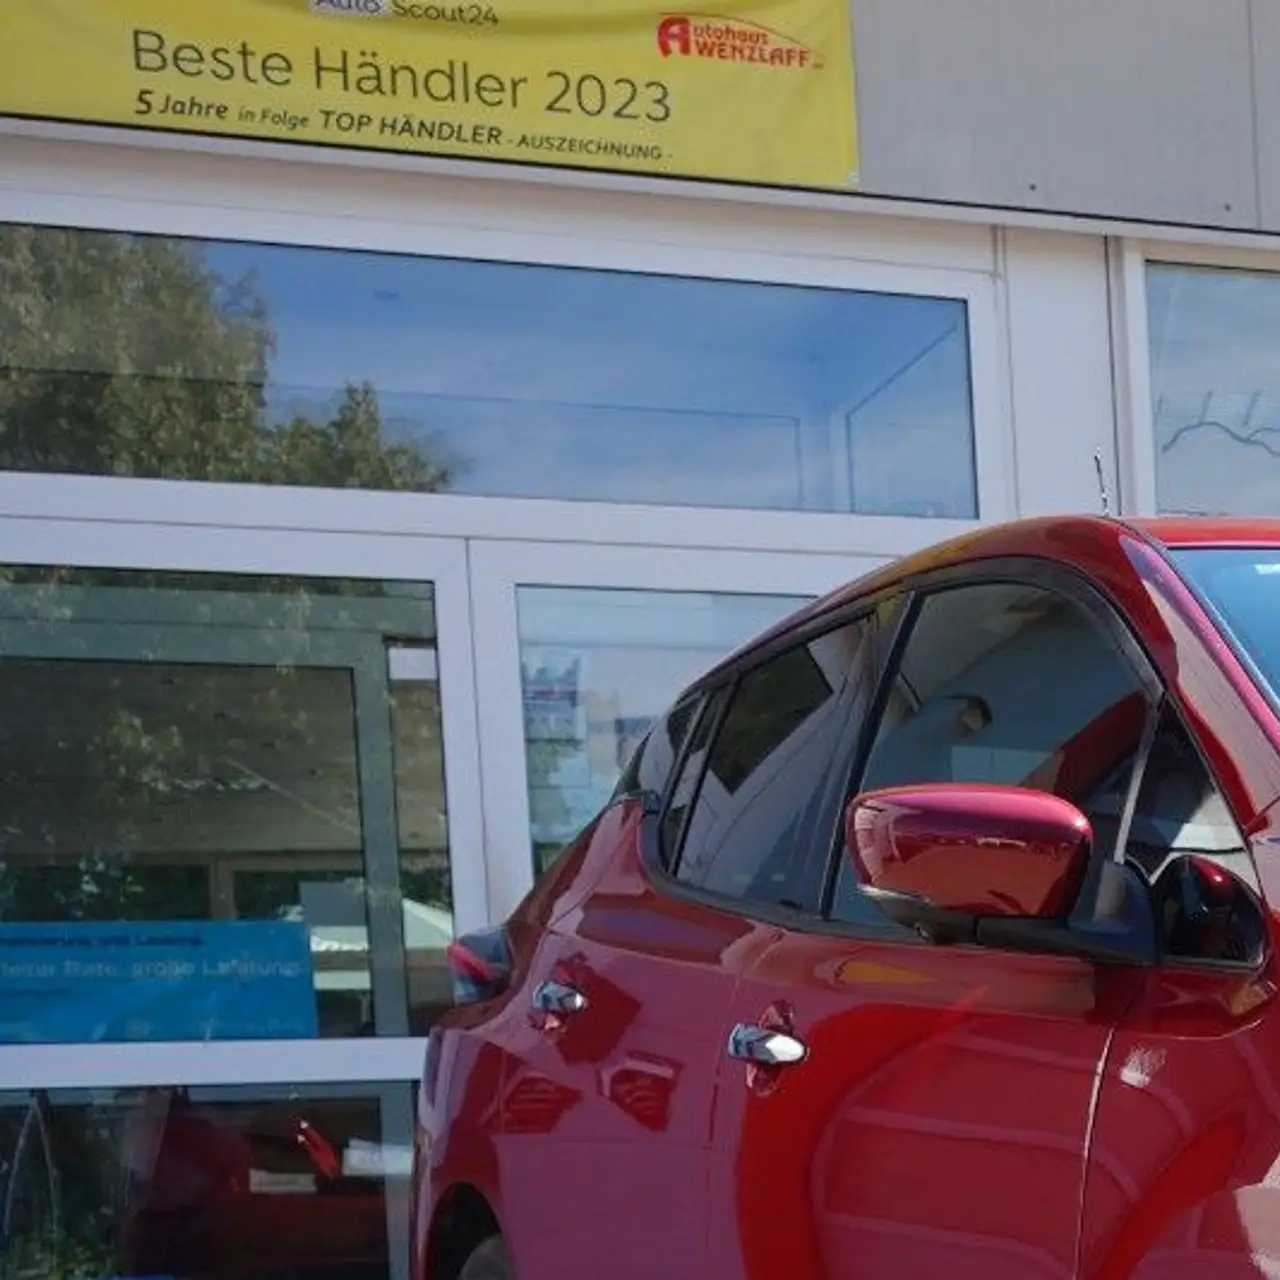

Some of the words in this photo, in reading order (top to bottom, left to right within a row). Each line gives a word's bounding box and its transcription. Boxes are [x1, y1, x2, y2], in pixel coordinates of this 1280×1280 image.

[132, 28, 293, 87] Beste
[314, 46, 528, 109] Händler
[544, 70, 672, 123] 2023
[134, 88, 154, 115] 5
[158, 94, 229, 120] Jahre
[237, 107, 257, 122] in
[261, 108, 310, 130] Folge
[319, 109, 373, 133] TOP
[379, 113, 504, 145] HÄNDLER
[517, 133, 663, 160] AUSZEICHNUNG
